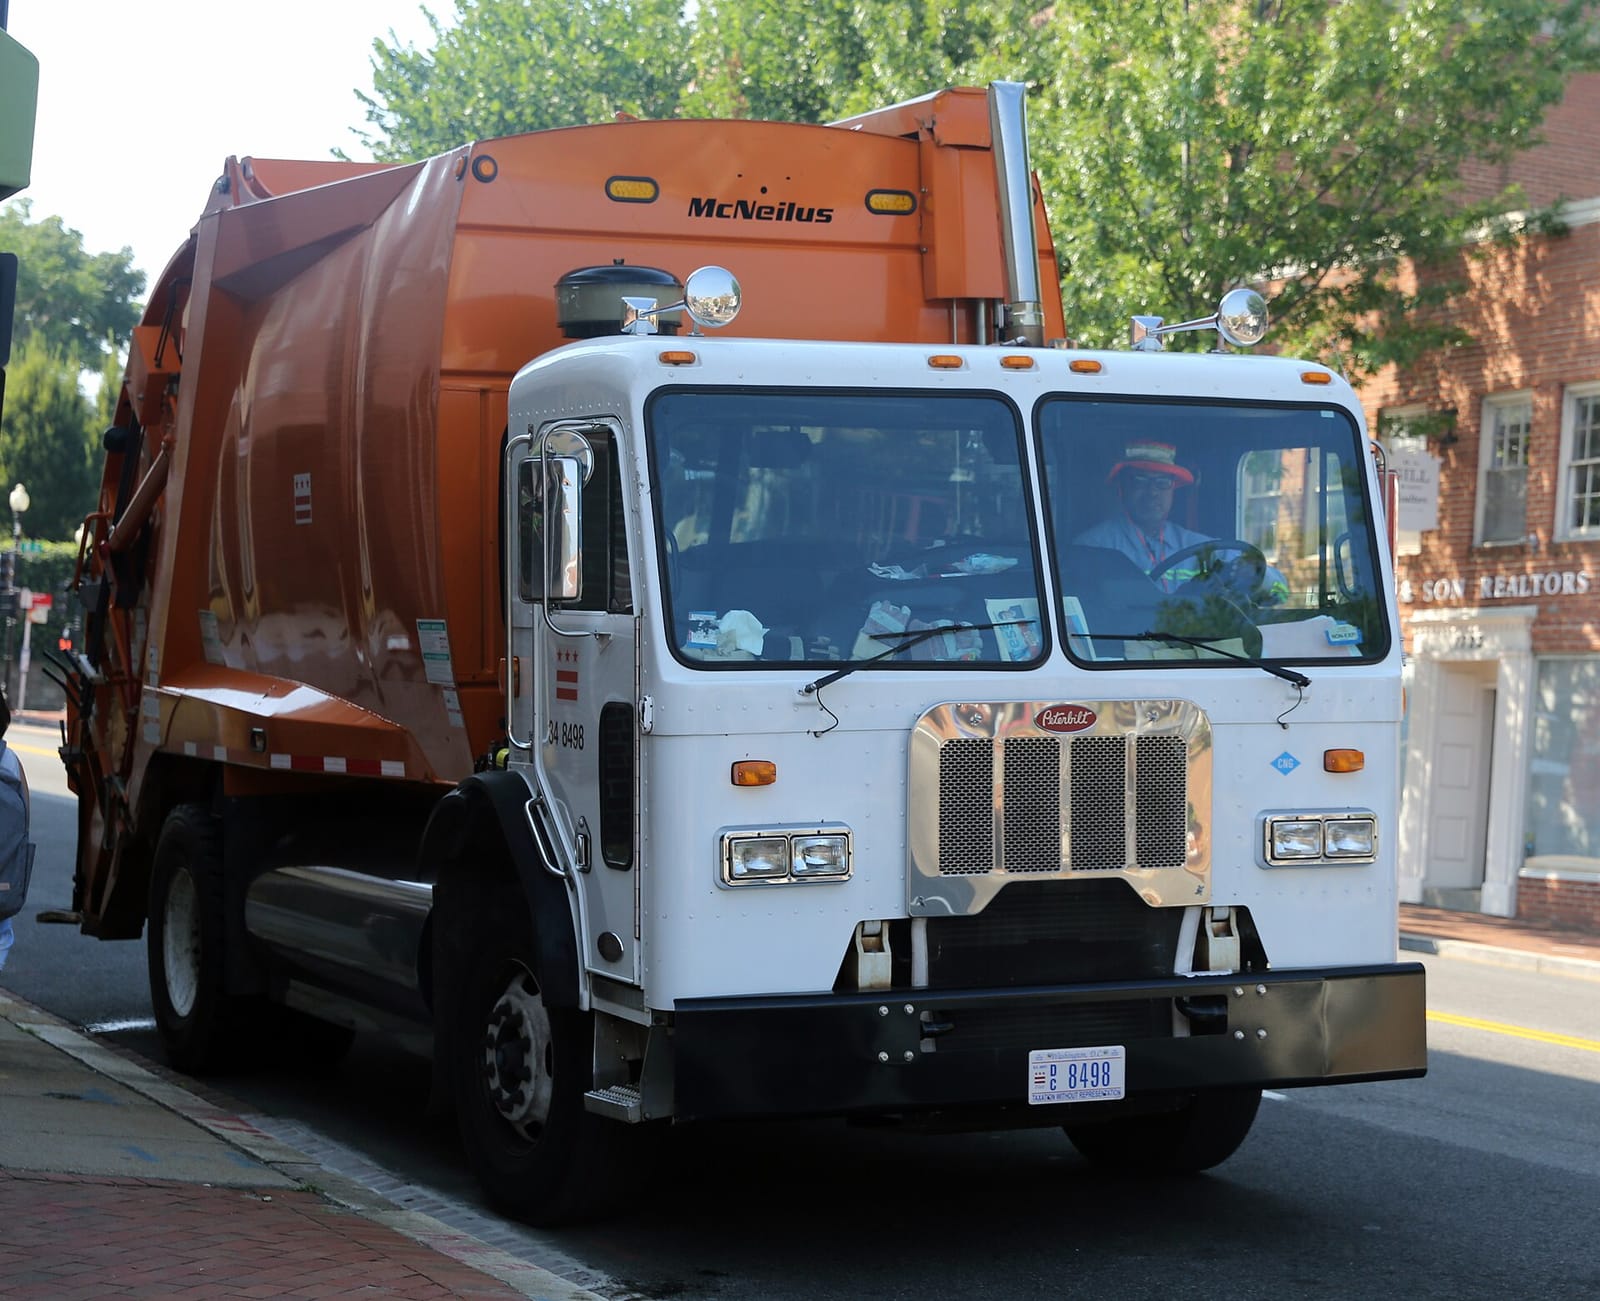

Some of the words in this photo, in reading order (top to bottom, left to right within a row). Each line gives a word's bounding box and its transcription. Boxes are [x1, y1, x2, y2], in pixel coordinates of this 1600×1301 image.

[688, 197, 834, 224] McNeilus
[1400, 579, 1414, 603] &
[1422, 577, 1466, 602] SON
[1480, 570, 1590, 599] REALTORS
[1042, 709, 1093, 727] Peterbilt
[562, 722, 584, 750] 8498
[1069, 1061, 1110, 1089] 8498
